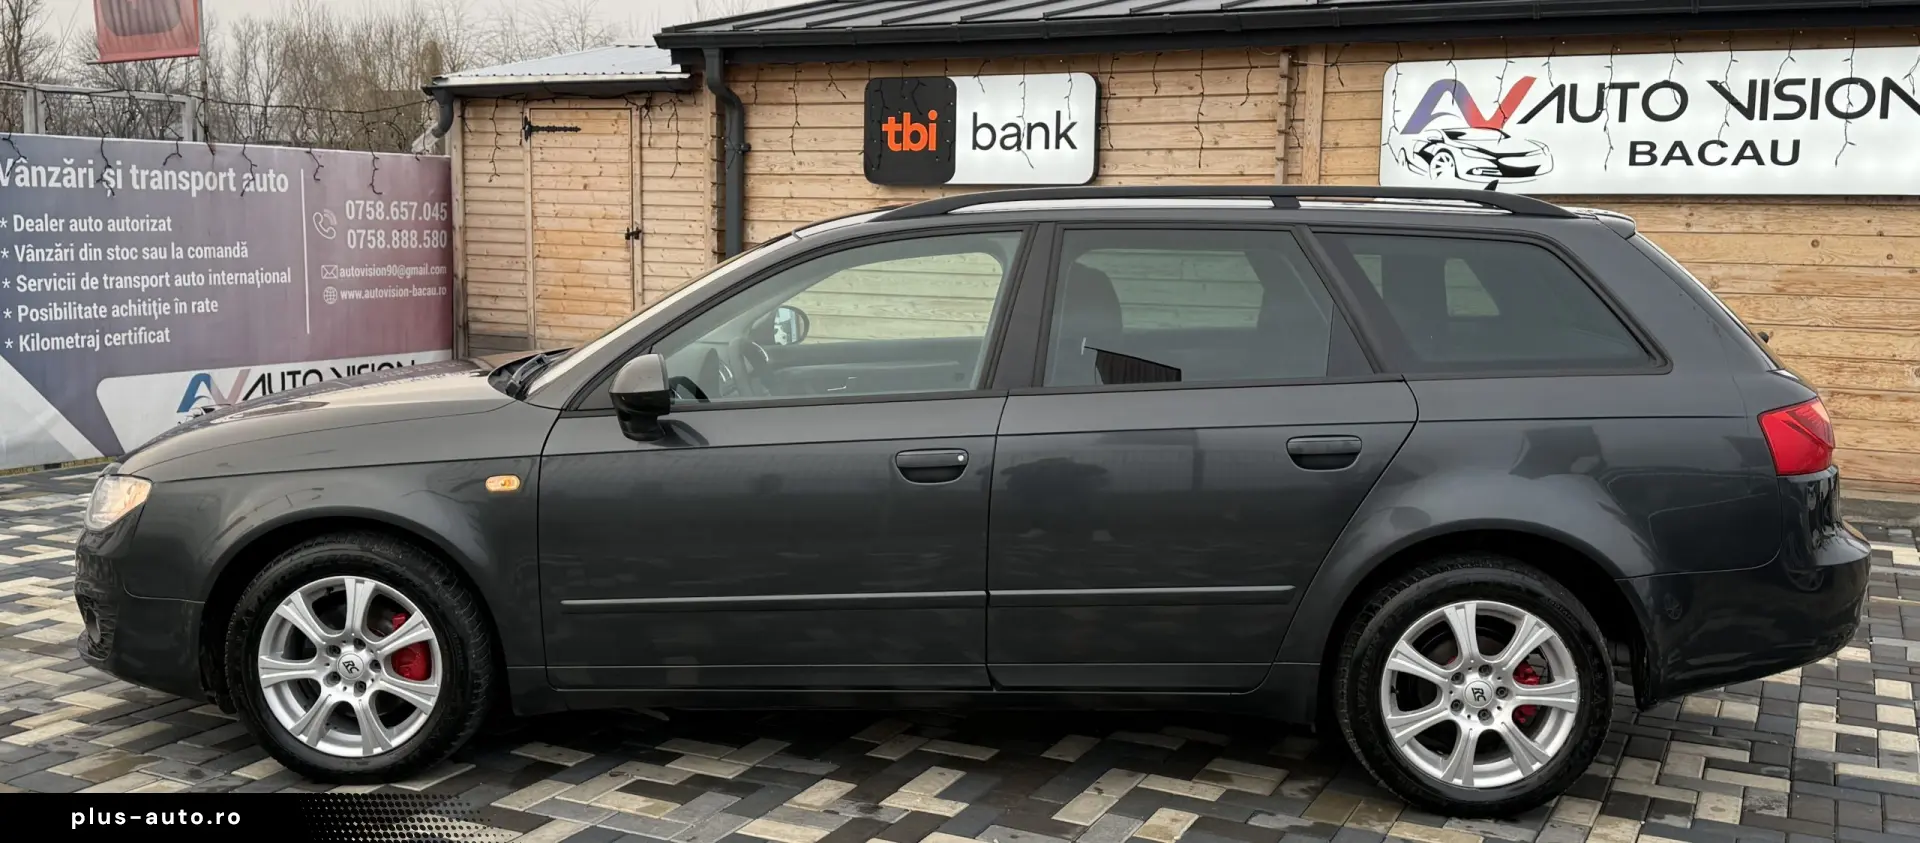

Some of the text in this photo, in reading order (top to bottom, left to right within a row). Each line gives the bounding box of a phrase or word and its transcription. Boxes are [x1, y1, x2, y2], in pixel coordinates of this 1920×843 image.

[1517, 76, 1920, 124] AUTO VISION
[882, 110, 1078, 152] tbi bank
[1628, 139, 1800, 167] BACAU
[0, 158, 94, 189] Vânzări
[130, 164, 236, 197] transport
[242, 169, 289, 193] auto
[345, 200, 447, 221] 0758.657.045
[13, 213, 172, 233] Dealer auto autorizat
[347, 229, 447, 249] 0758.888.580
[14, 240, 249, 263] Vânzări din stoc sau la comandă
[16, 274, 76, 293] Servicii
[80, 273, 99, 291] de
[103, 271, 172, 292] transport
[175, 272, 205, 287] auto
[340, 262, 447, 279] autovision90@gmail.com
[340, 284, 447, 300] www.autovision-bacau.ro
[17, 301, 108, 323] Posibilitate
[174, 298, 188, 315] în
[191, 298, 219, 315] rate
[19, 327, 171, 352] Kilometraj certificat
